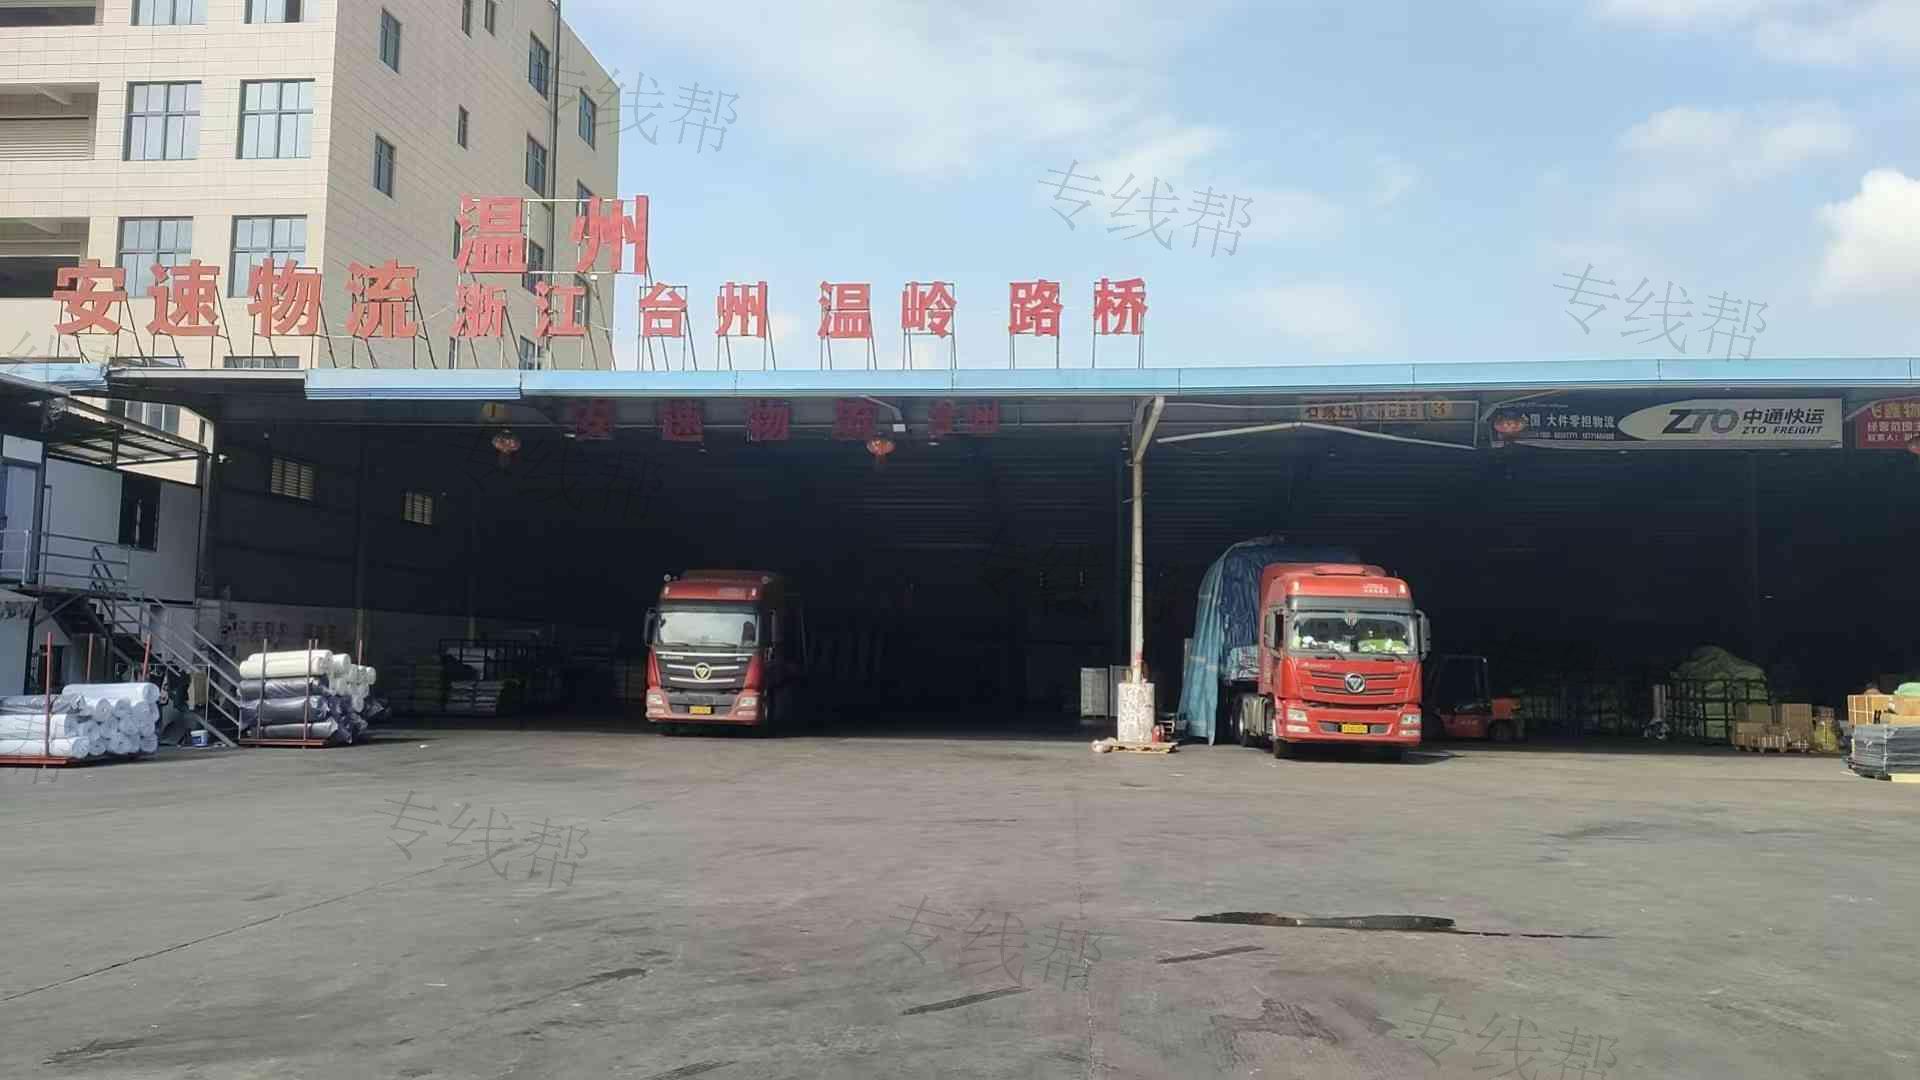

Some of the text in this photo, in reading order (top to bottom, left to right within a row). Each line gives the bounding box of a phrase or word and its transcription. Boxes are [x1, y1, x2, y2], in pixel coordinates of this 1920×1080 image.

[457, 194, 648, 275] 温州
[53, 258, 418, 338] 安速物流
[451, 277, 1148, 339] 浙江台州温岭路桥
[1662, 408, 1739, 435] ZTO
[1742, 425, 1823, 434] ZTO FREIGHT
[1743, 408, 1825, 425] 中通快运
